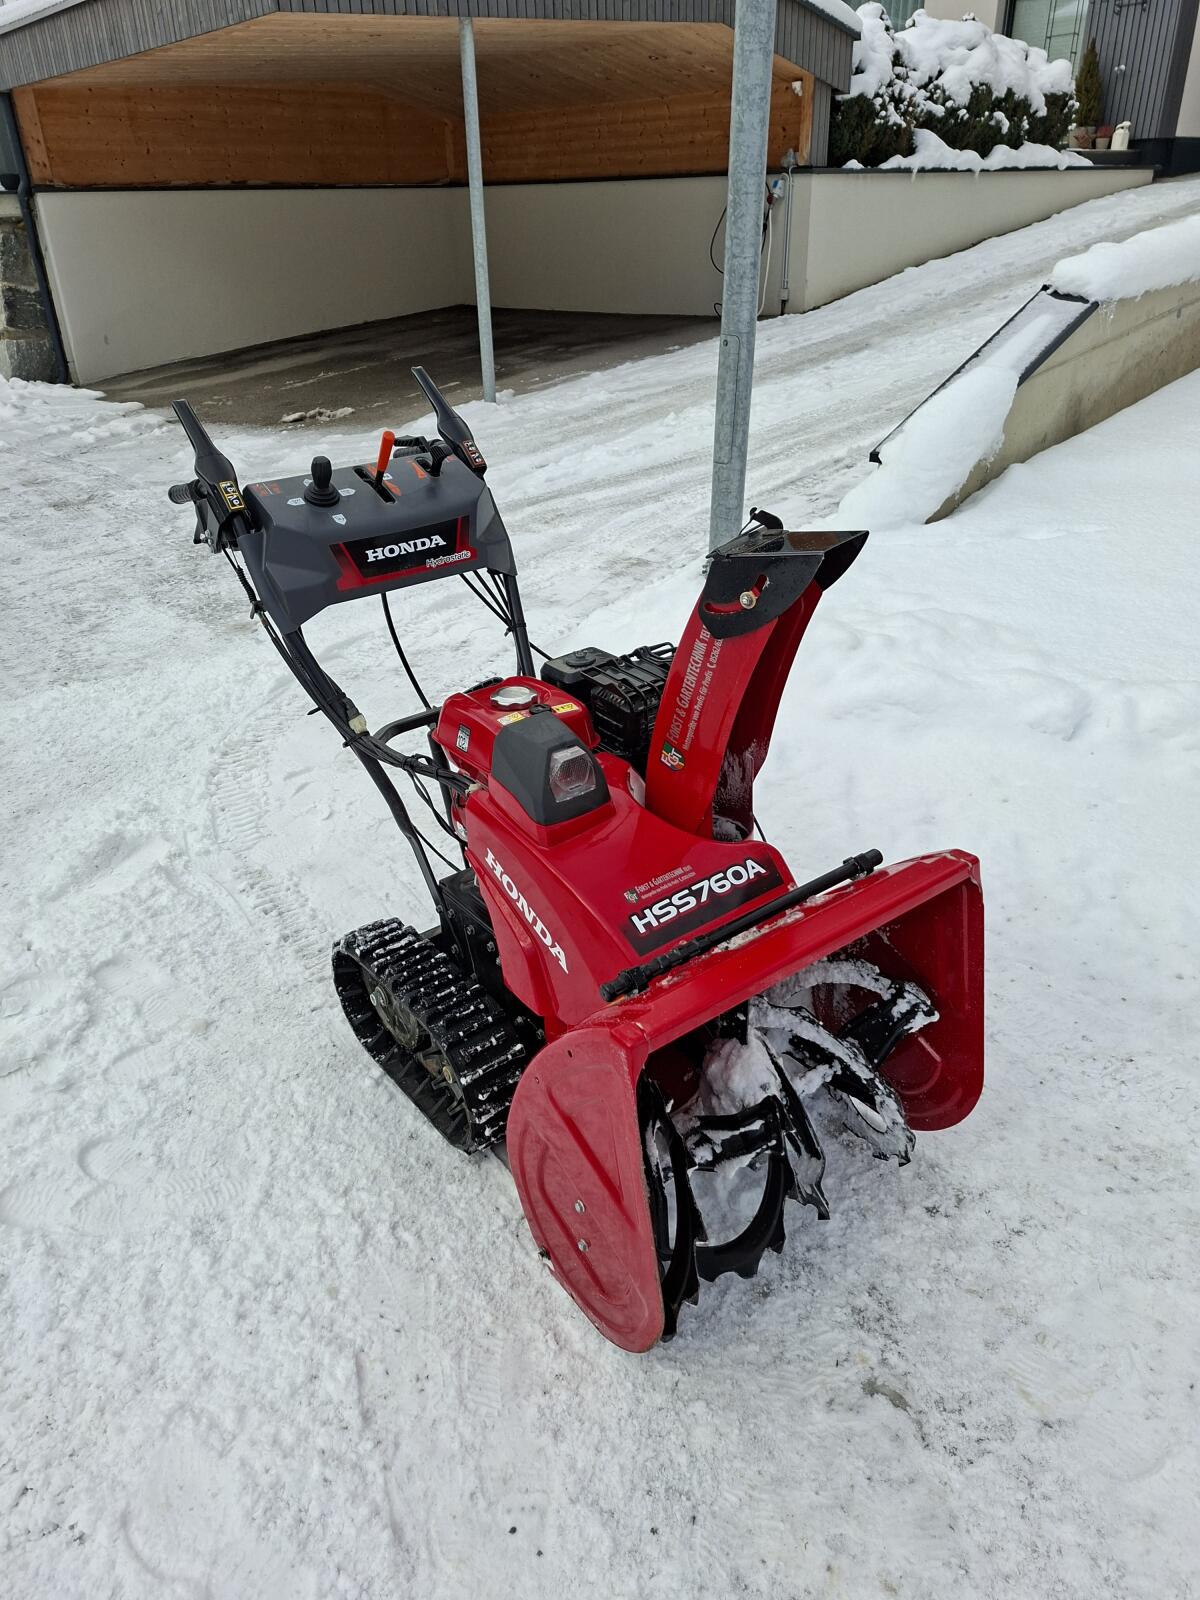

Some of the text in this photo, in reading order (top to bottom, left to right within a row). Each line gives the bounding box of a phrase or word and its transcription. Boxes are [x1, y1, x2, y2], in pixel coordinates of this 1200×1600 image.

[365, 535, 447, 562] HONDA
[425, 550, 471, 568] Hydrostatic
[676, 639, 707, 709] GARTENTECHNIK
[694, 695, 705, 713] Profis
[702, 670, 713, 688] Profis
[668, 714, 684, 744] FORST
[677, 707, 687, 718] &
[484, 847, 568, 975] HONDA
[631, 859, 767, 934] HSS760A
